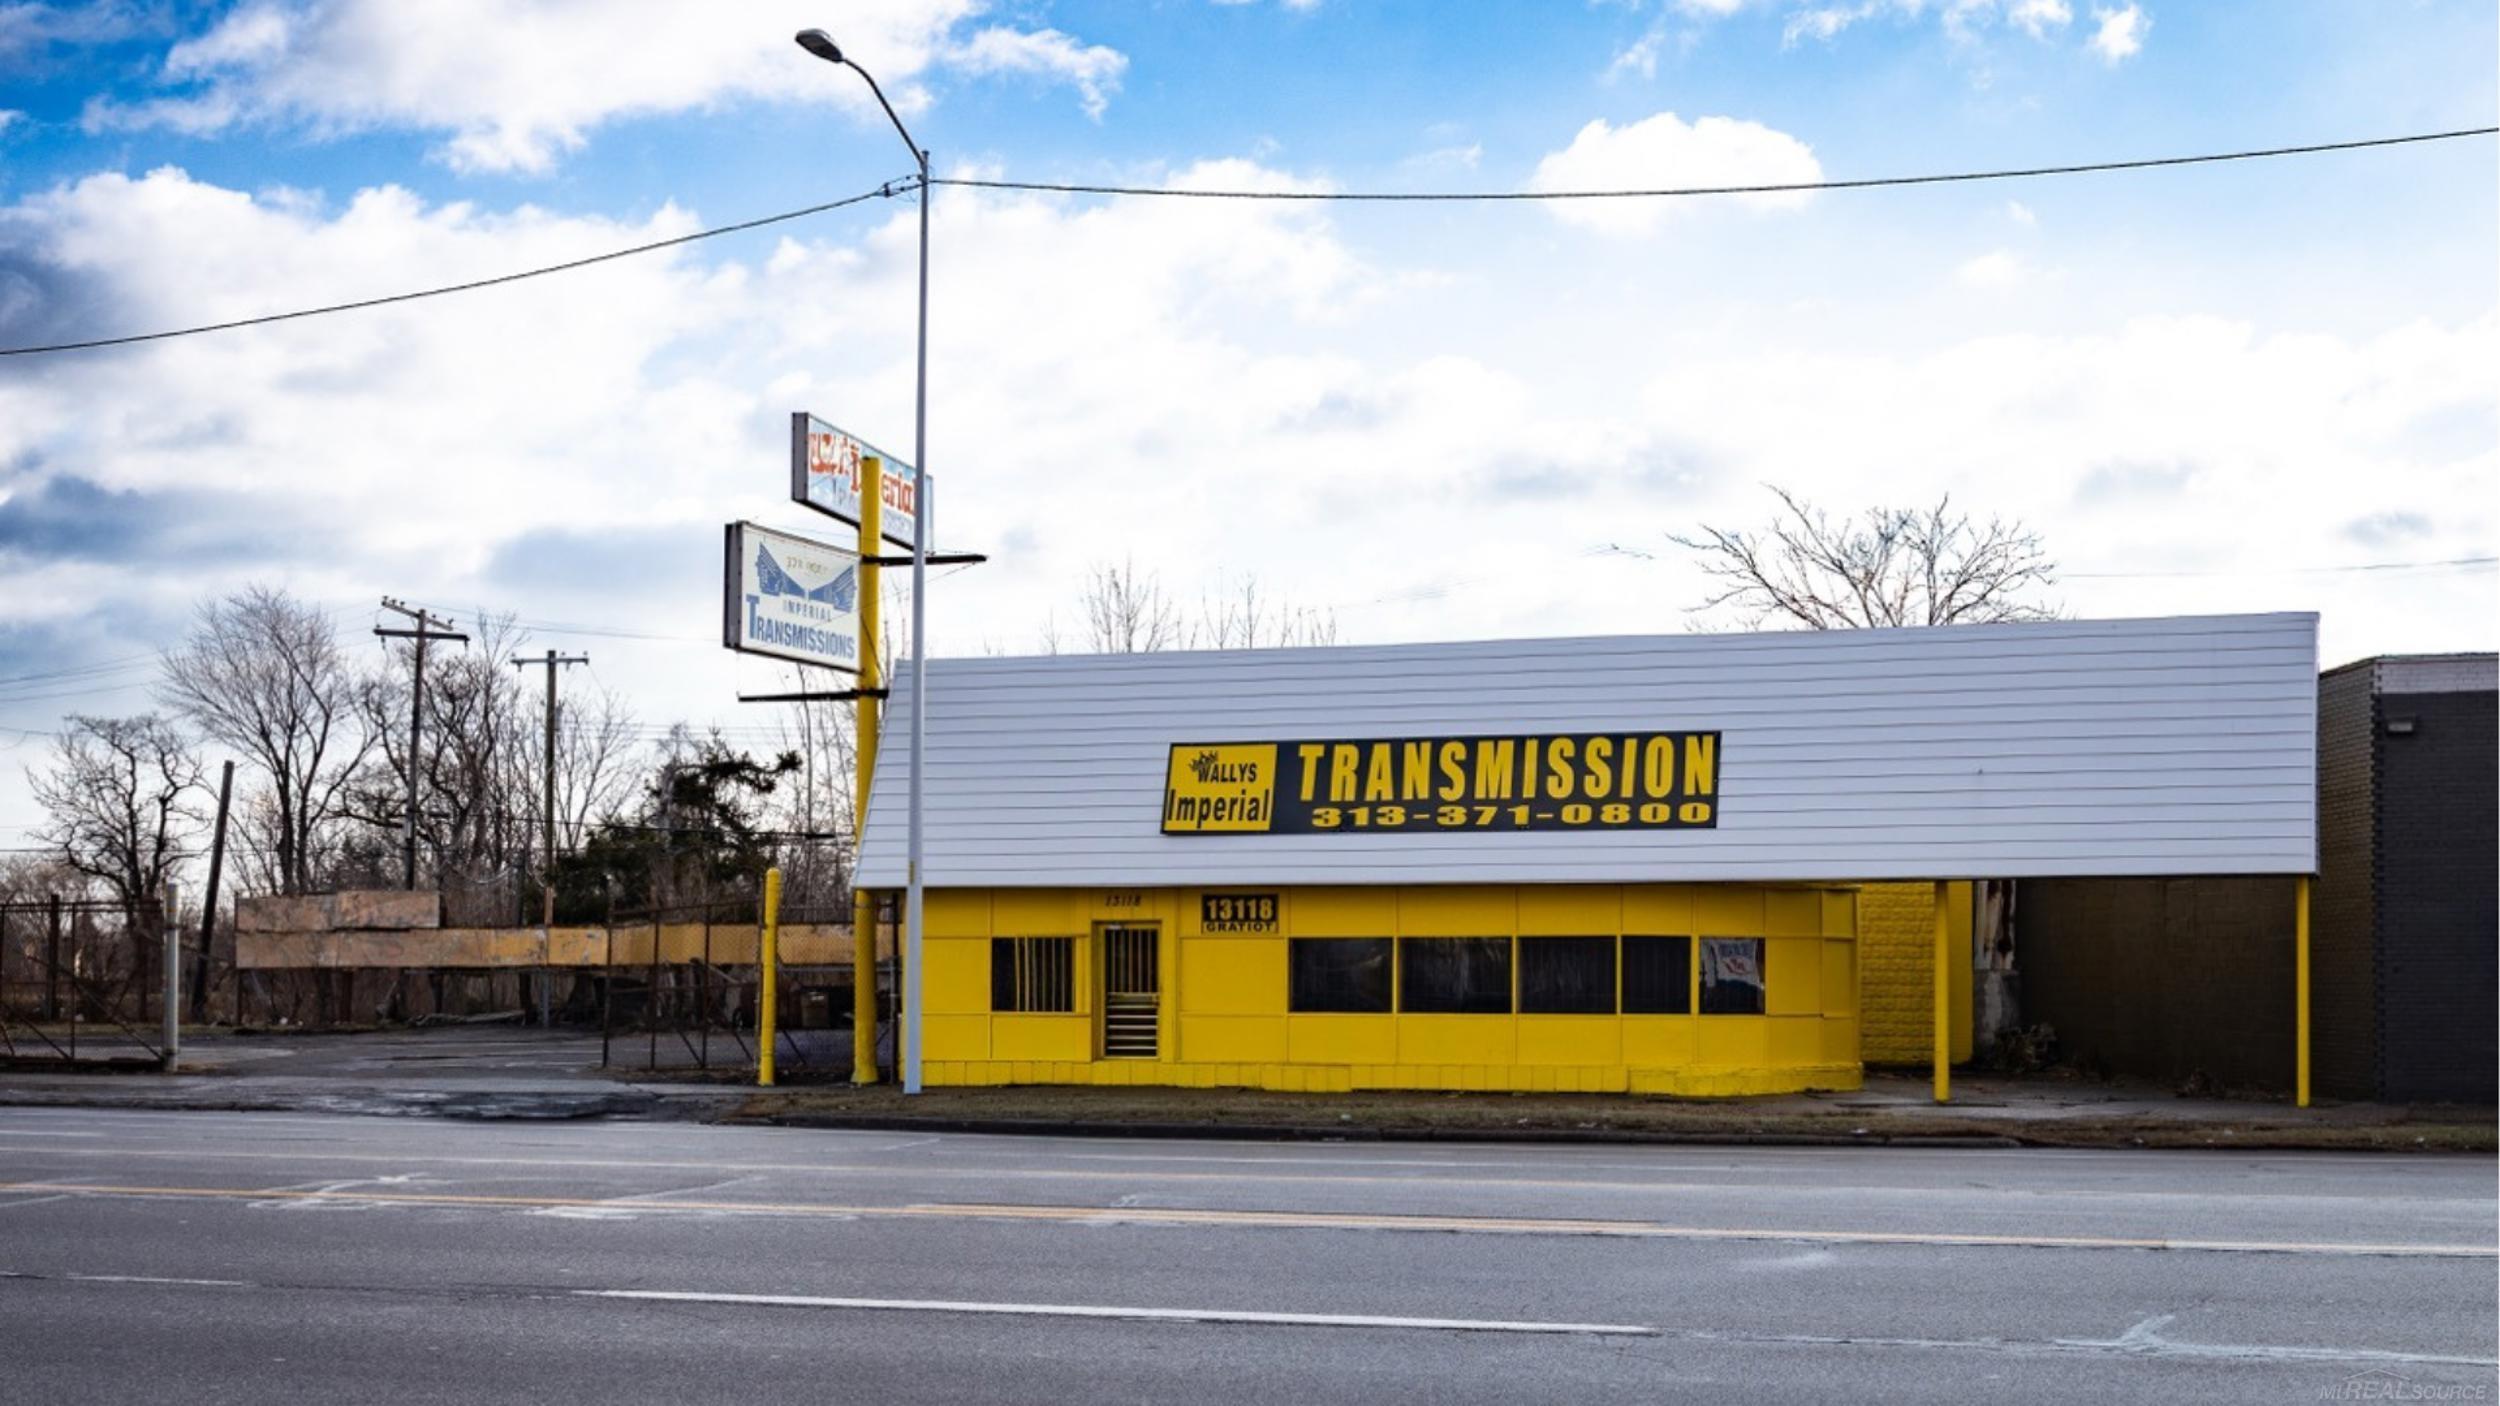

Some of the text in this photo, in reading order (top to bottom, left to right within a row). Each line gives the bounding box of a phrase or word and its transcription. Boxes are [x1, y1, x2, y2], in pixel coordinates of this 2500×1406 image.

[746, 594, 855, 659] TRANSMISSIONS
[1198, 762, 1257, 783] WALLYS
[1299, 736, 1714, 801] TRANSMISSION
[1167, 789, 1270, 829] Imperial
[1312, 803, 1711, 827] 313-371-0800
[1208, 898, 1273, 921] 13118
[1206, 922, 1272, 932] GRATIOT
